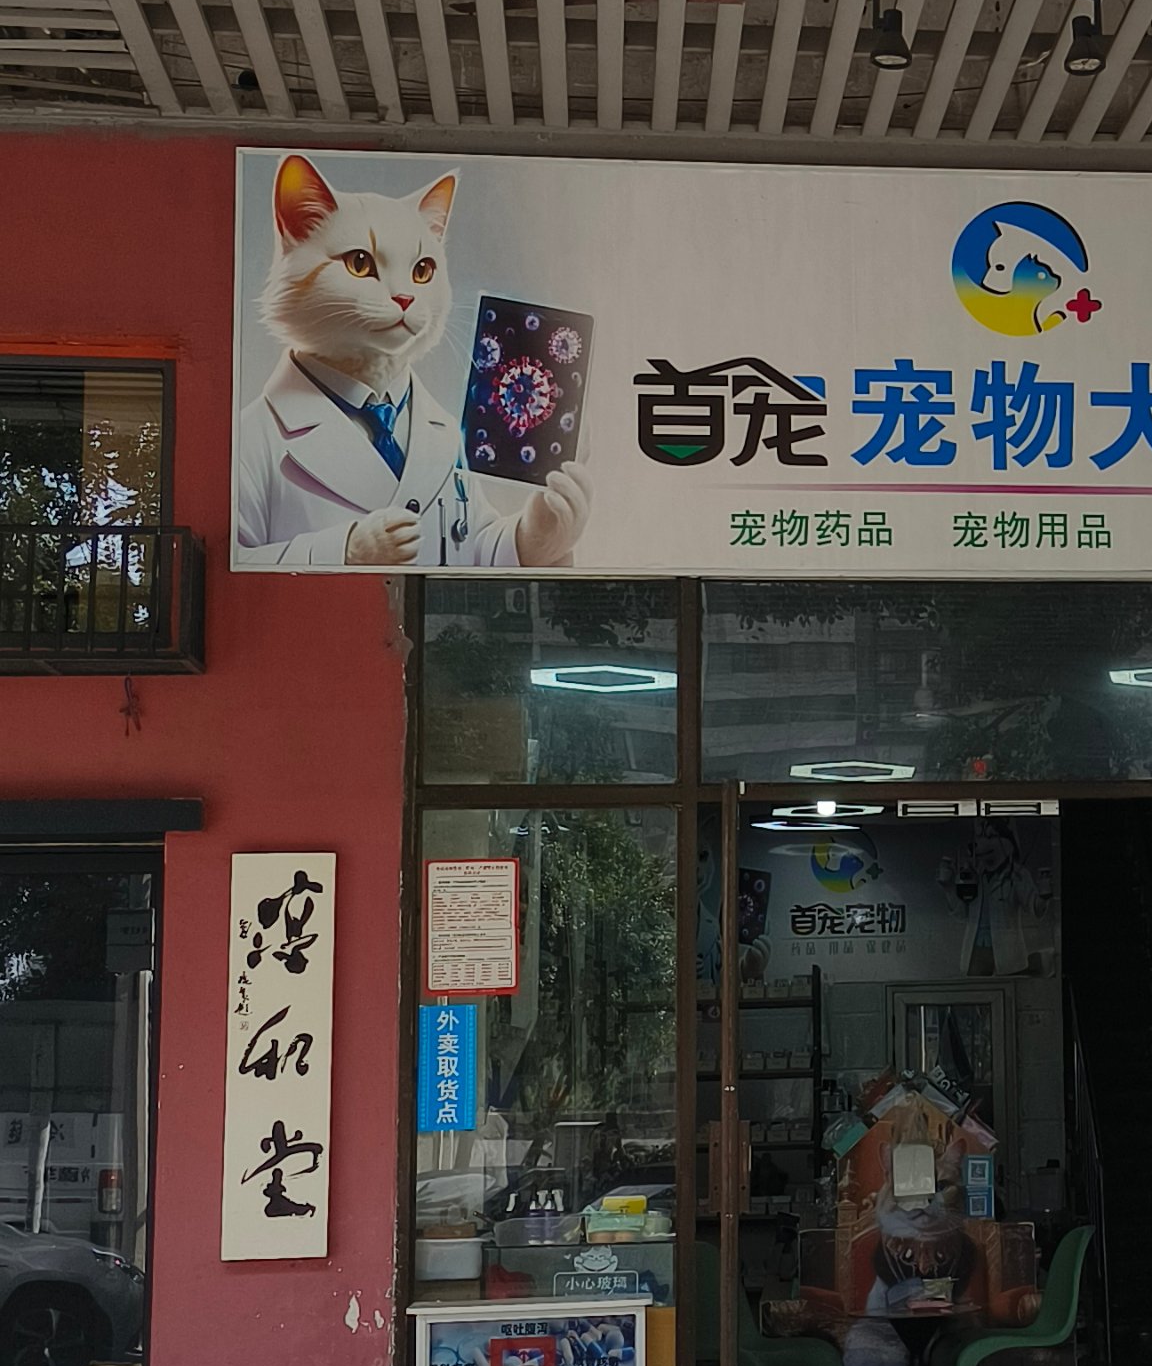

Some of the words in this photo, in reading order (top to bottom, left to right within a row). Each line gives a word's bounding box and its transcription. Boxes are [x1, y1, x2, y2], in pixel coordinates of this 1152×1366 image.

[633, 357, 828, 467] 首宠
[729, 510, 893, 547] 宠物药品
[952, 511, 1113, 549] 宠物用品
[436, 1010, 460, 1124] 外卖取货点
[565, 1276, 627, 1291] 小心玻璃
